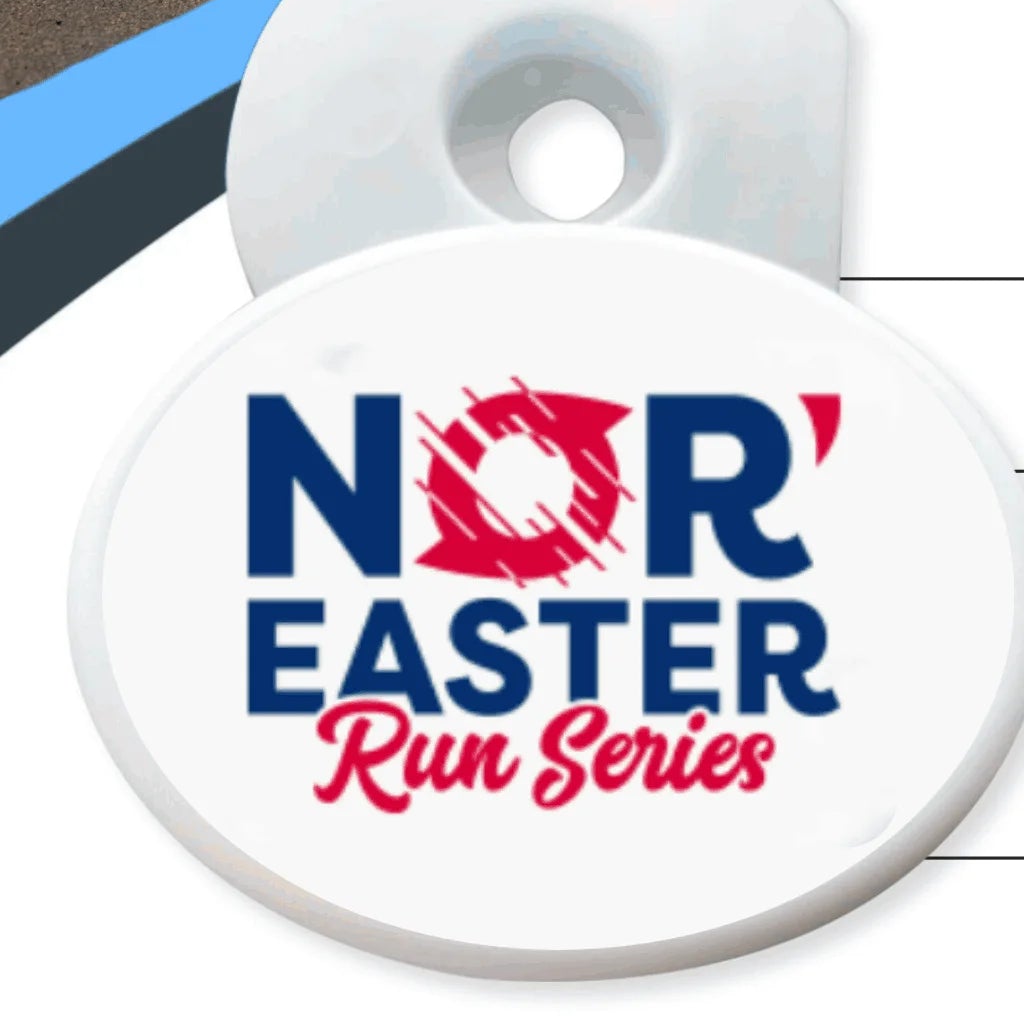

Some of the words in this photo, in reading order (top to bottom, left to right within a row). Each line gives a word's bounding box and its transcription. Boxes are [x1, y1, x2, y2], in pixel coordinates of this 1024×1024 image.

[249, 599, 840, 716] EASTER
[314, 700, 520, 814] Run
[532, 705, 776, 810] Series
